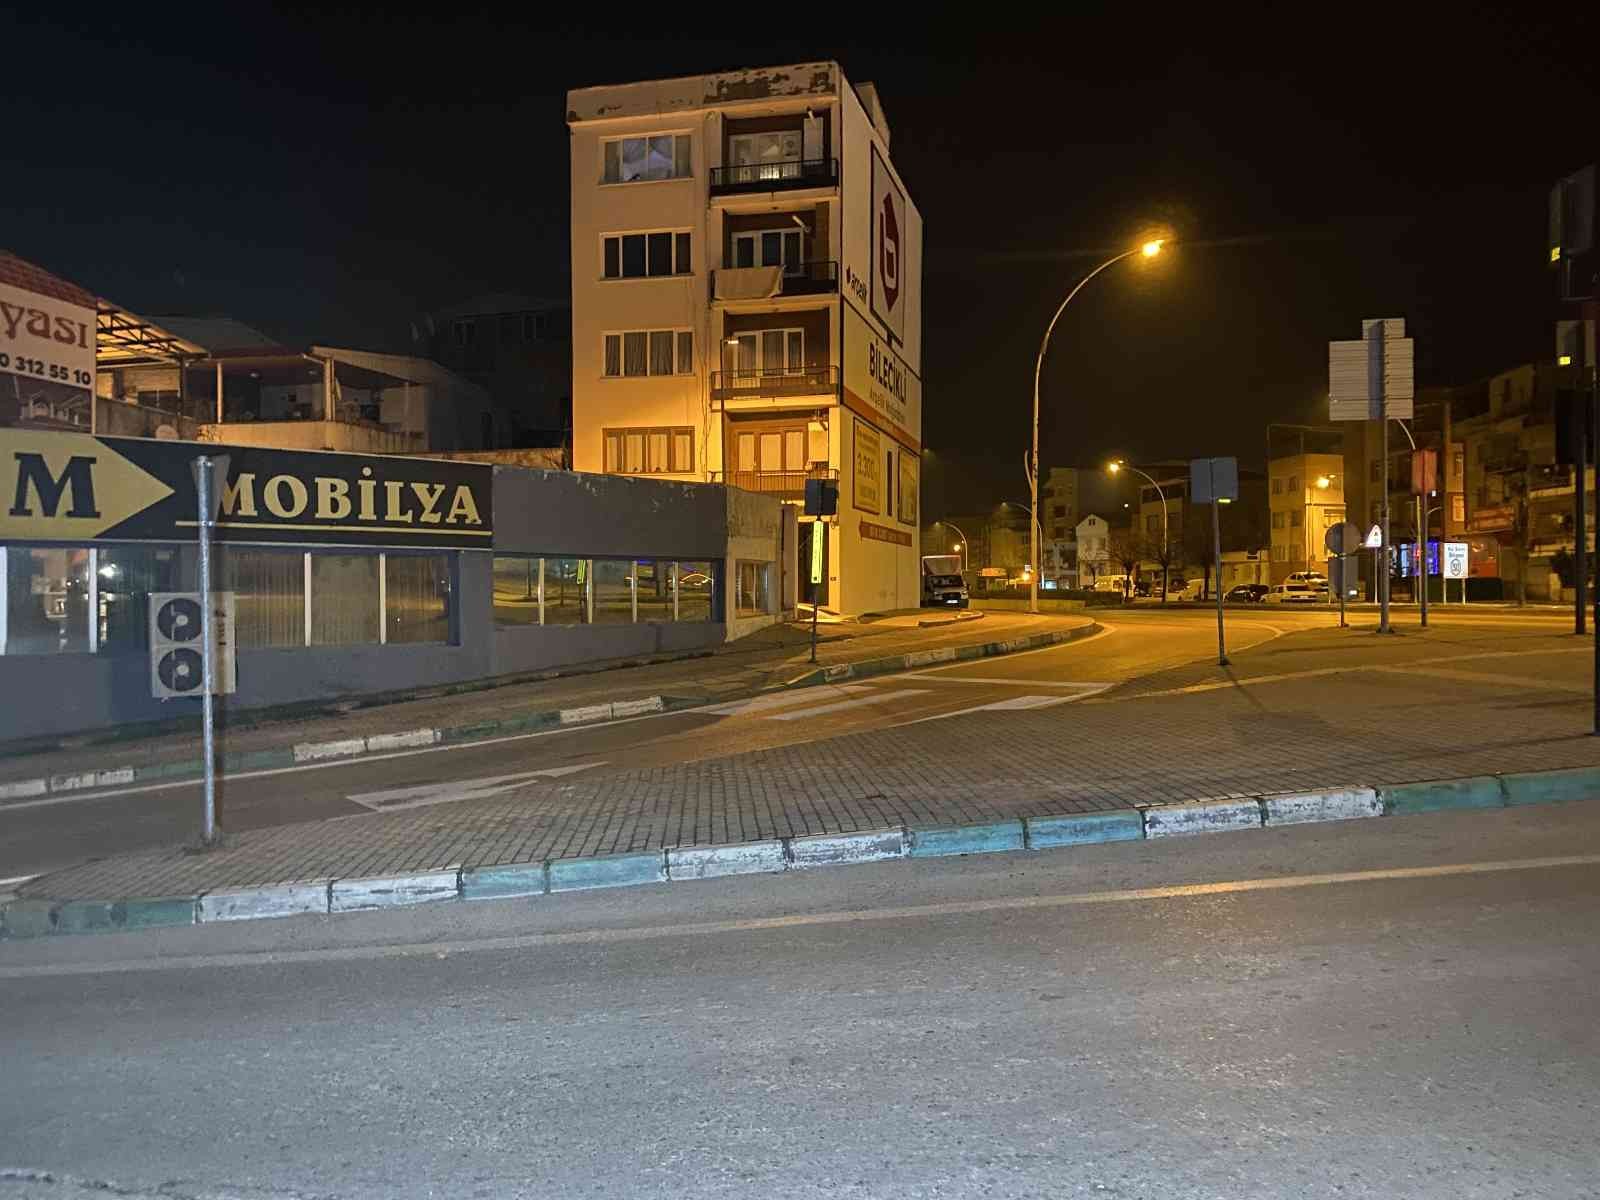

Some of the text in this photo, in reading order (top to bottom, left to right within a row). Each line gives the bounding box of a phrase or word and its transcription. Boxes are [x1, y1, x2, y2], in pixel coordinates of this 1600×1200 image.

[0, 301, 88, 349] yası
[15, 356, 44, 375] 312
[49, 364, 69, 380] 55
[73, 368, 91, 385] 10
[9, 452, 101, 518] M
[219, 466, 482, 525] MOBİLYA
